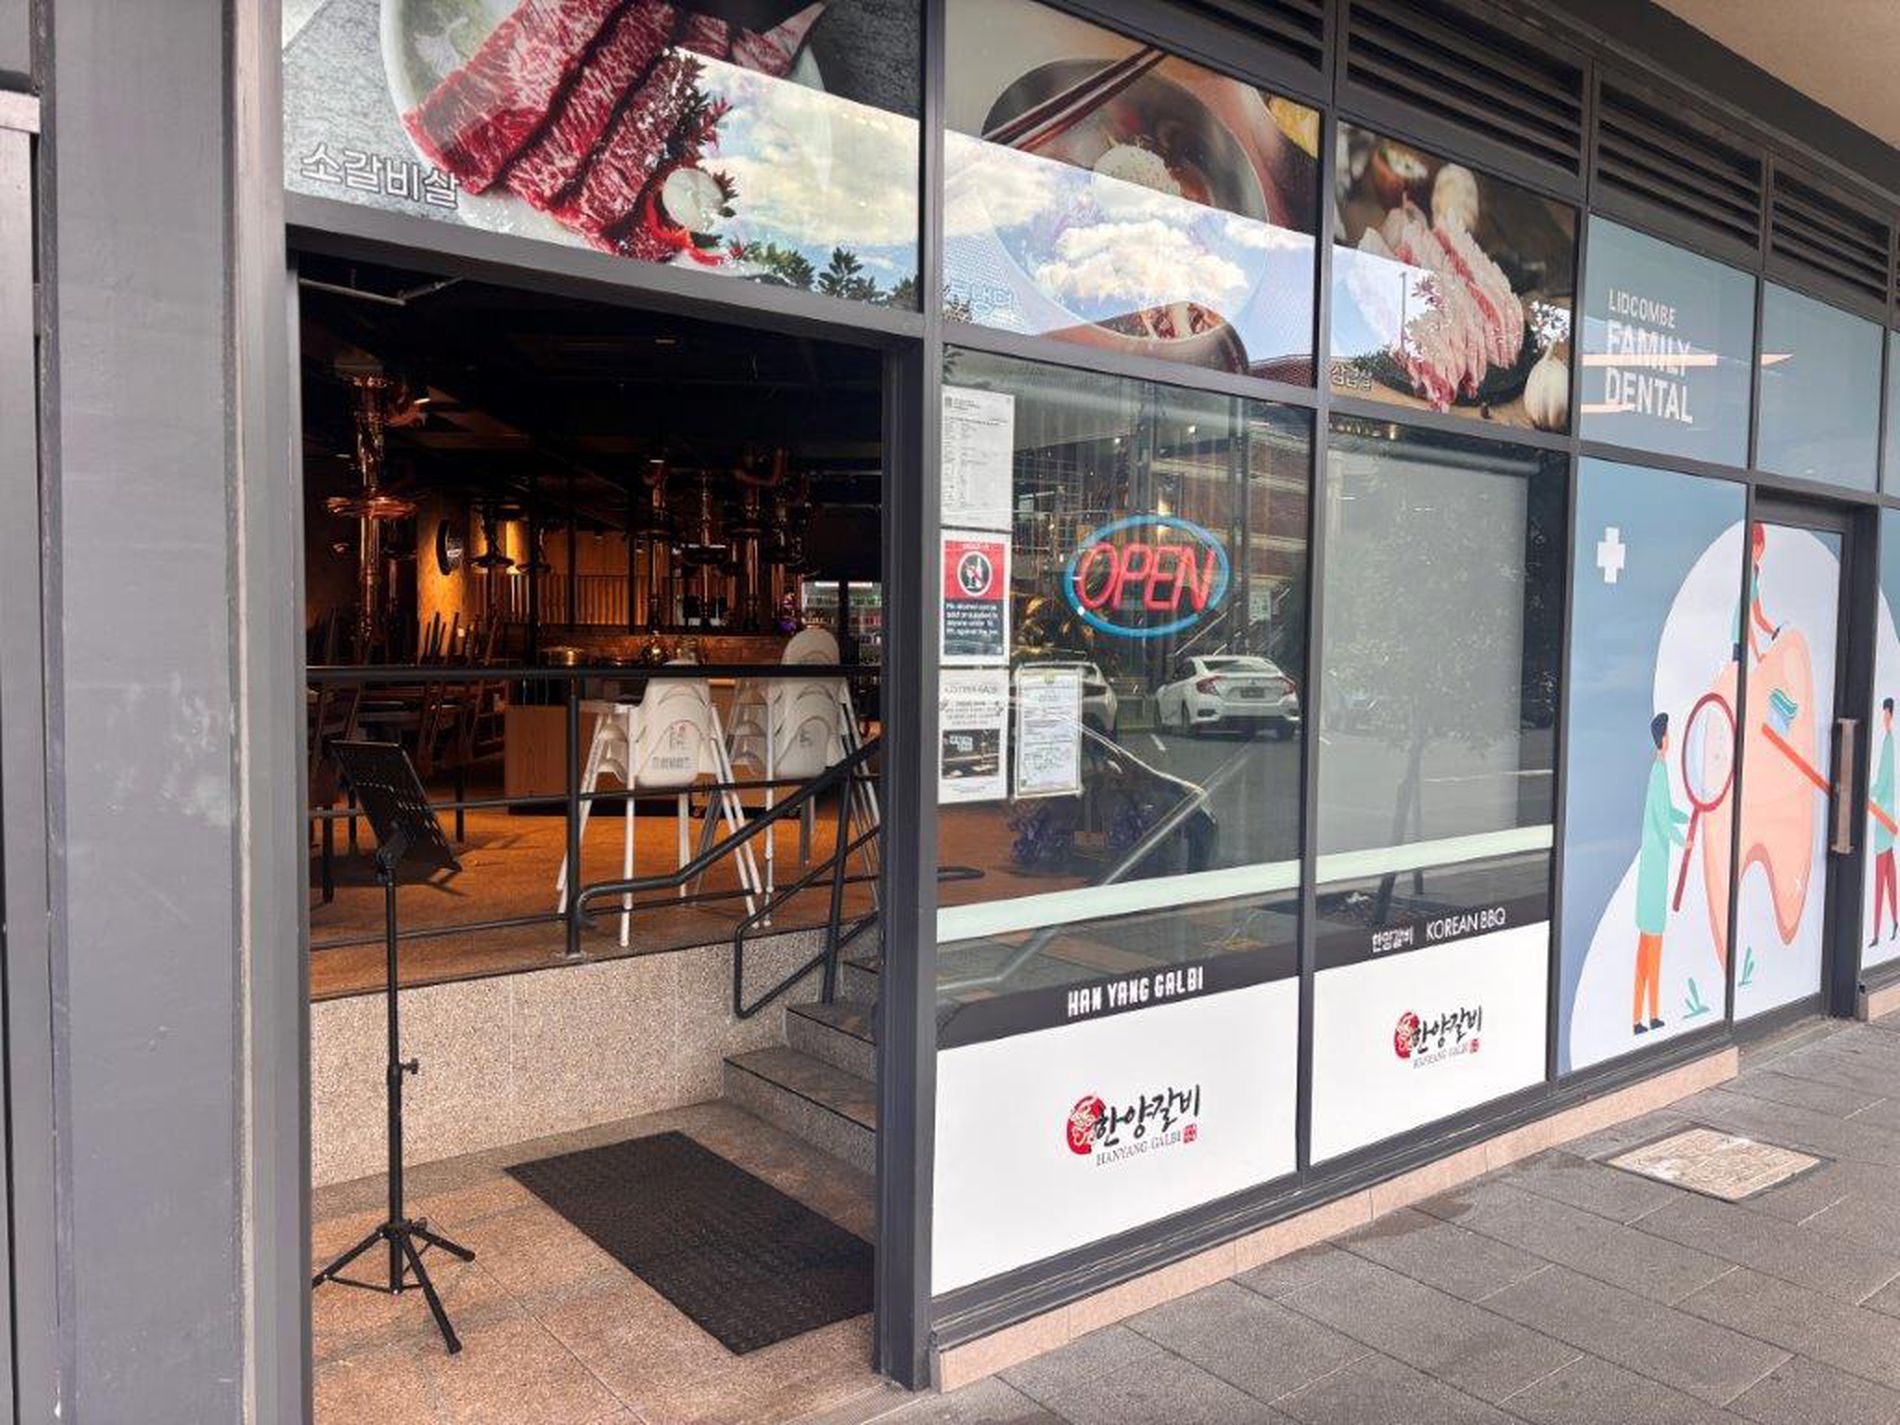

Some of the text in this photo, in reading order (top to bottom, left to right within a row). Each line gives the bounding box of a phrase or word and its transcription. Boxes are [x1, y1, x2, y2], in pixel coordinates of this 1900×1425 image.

[302, 143, 460, 209] 소갈비살
[1608, 288, 1676, 329] LIDCOMBE
[1606, 318, 1691, 377] FAMILY
[1604, 366, 1693, 425] DENTAL
[1076, 542, 1216, 613] OPEN
[1426, 907, 1506, 942] KOREAN BBQ
[1068, 965, 1204, 1018] HAN YANG GALBI
[1411, 1005, 1482, 1055] 한양갈비
[1094, 1084, 1200, 1148] 한양갈비
[1096, 1140, 1149, 1166] HANYANG
